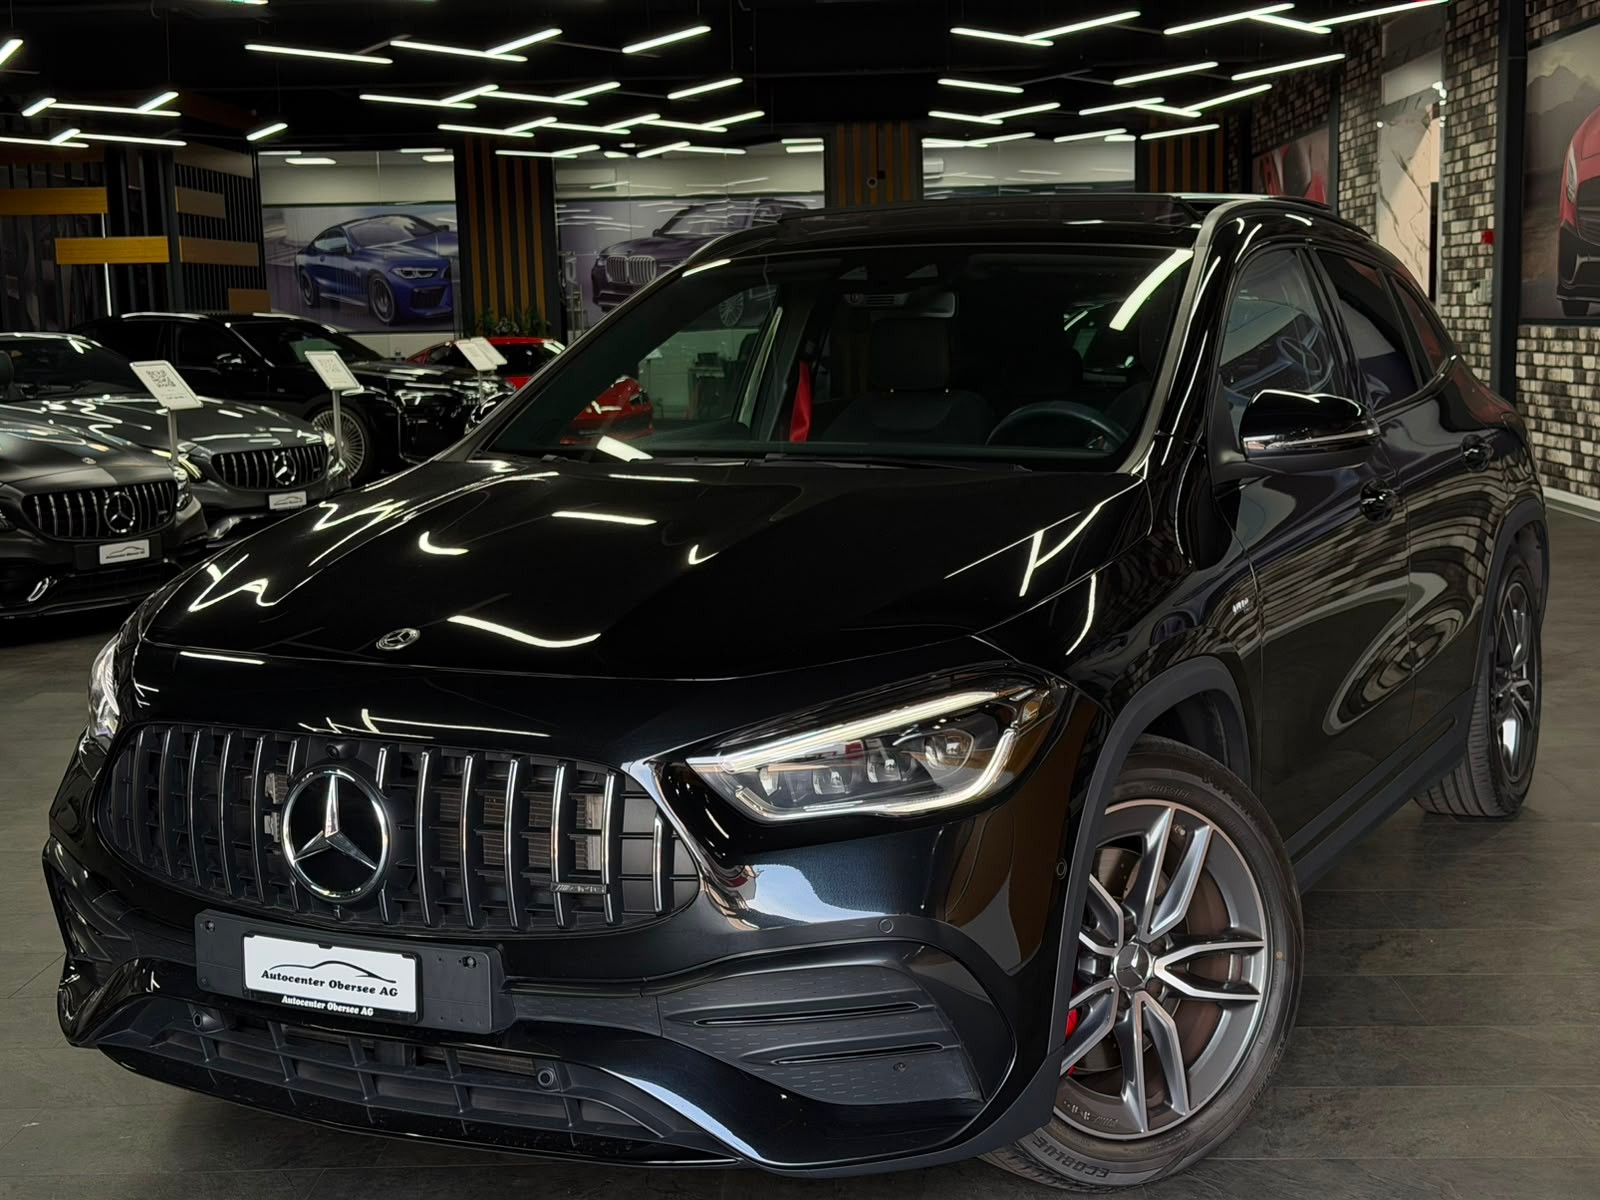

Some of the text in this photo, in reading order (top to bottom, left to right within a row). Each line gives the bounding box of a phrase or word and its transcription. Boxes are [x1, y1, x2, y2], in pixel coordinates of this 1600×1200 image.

[261, 970, 398, 997] Autocenter Obersee AG
[281, 996, 374, 1016] Autocenter Obersee AG
[1031, 1133, 1110, 1178] ECOBLUE
